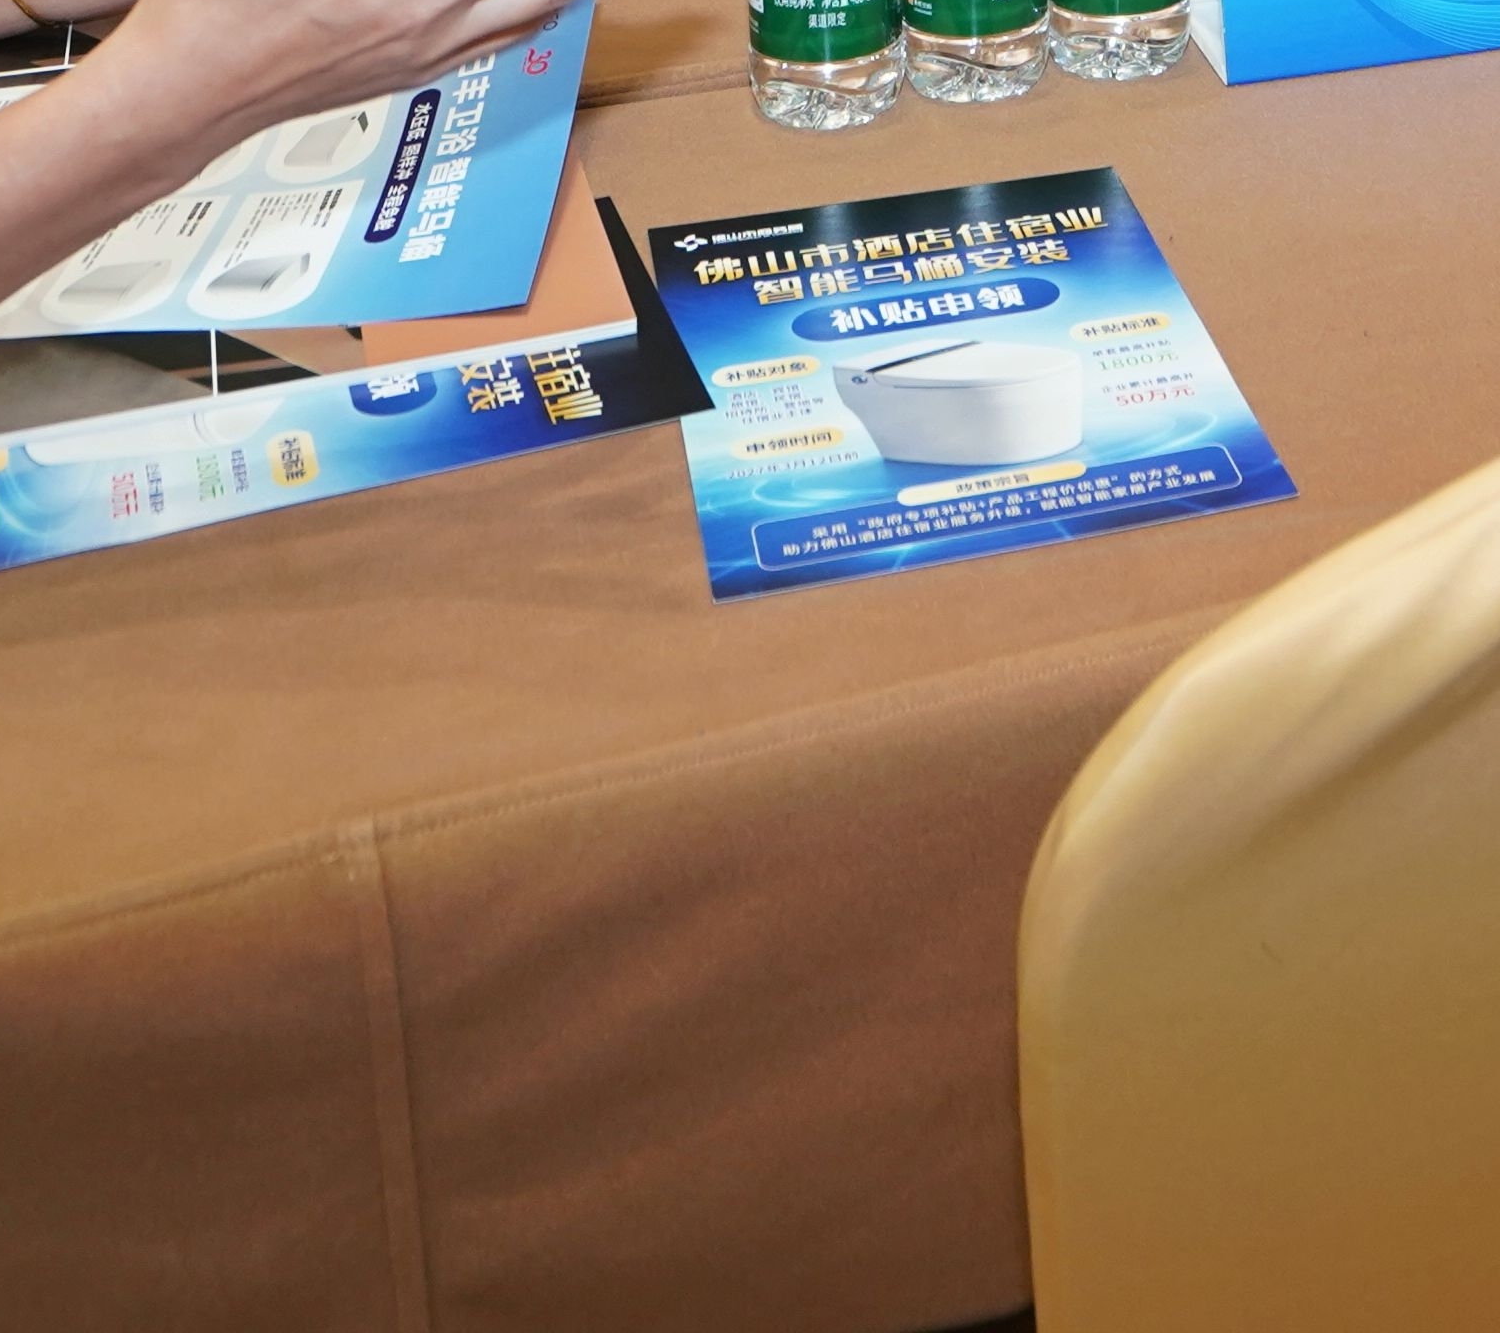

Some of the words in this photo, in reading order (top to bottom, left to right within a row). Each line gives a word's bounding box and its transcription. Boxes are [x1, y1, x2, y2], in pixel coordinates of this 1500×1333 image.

[808, 12, 846, 28] 渠道限定
[406, 102, 433, 141] 水压低
[399, 157, 472, 262] 智能马桶
[694, 206, 1109, 285] 佛山市酒店住宿业
[754, 239, 1071, 305] 智能马桶安装
[830, 283, 1025, 333] 补贴申领
[1083, 317, 1160, 337] 补贴标准
[726, 362, 807, 382] 补贴对象
[1100, 352, 1179, 371] 1800元
[456, 357, 524, 413] 安装
[1116, 385, 1195, 407] 50万元
[746, 432, 832, 453] 申领时间
